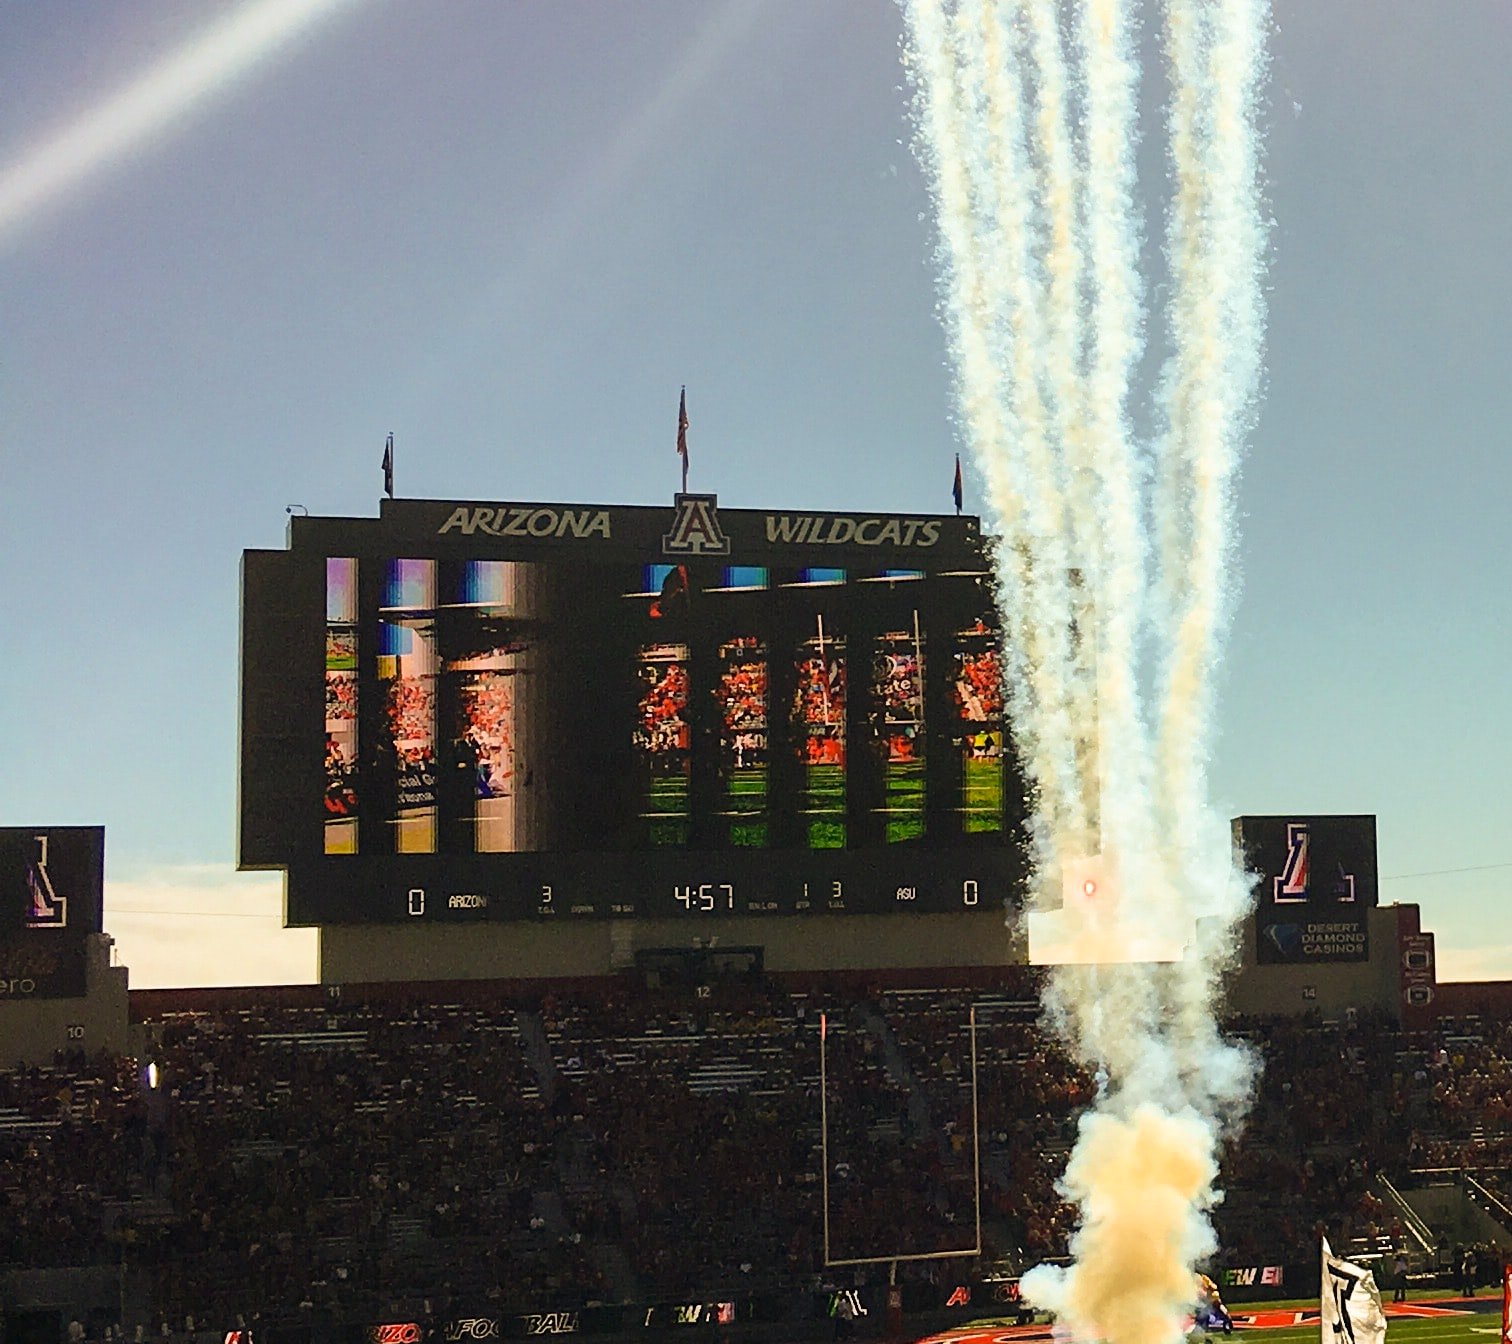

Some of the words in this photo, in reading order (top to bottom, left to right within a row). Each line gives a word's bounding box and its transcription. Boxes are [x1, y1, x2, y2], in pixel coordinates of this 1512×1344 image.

[438, 506, 612, 539] ARIZONA
[765, 515, 944, 547] WILDCATS
[542, 885, 552, 903] 3
[674, 884, 734, 911] 4:57
[832, 881, 842, 897] 3
[896, 887, 917, 900] ASU
[963, 880, 979, 906] 0
[408, 888, 425, 916] 0
[1307, 922, 1359, 934] DESERT
[1301, 933, 1366, 945] DIAMOND
[1303, 944, 1364, 955] CASINOS
[67, 1025, 85, 1038] 10
